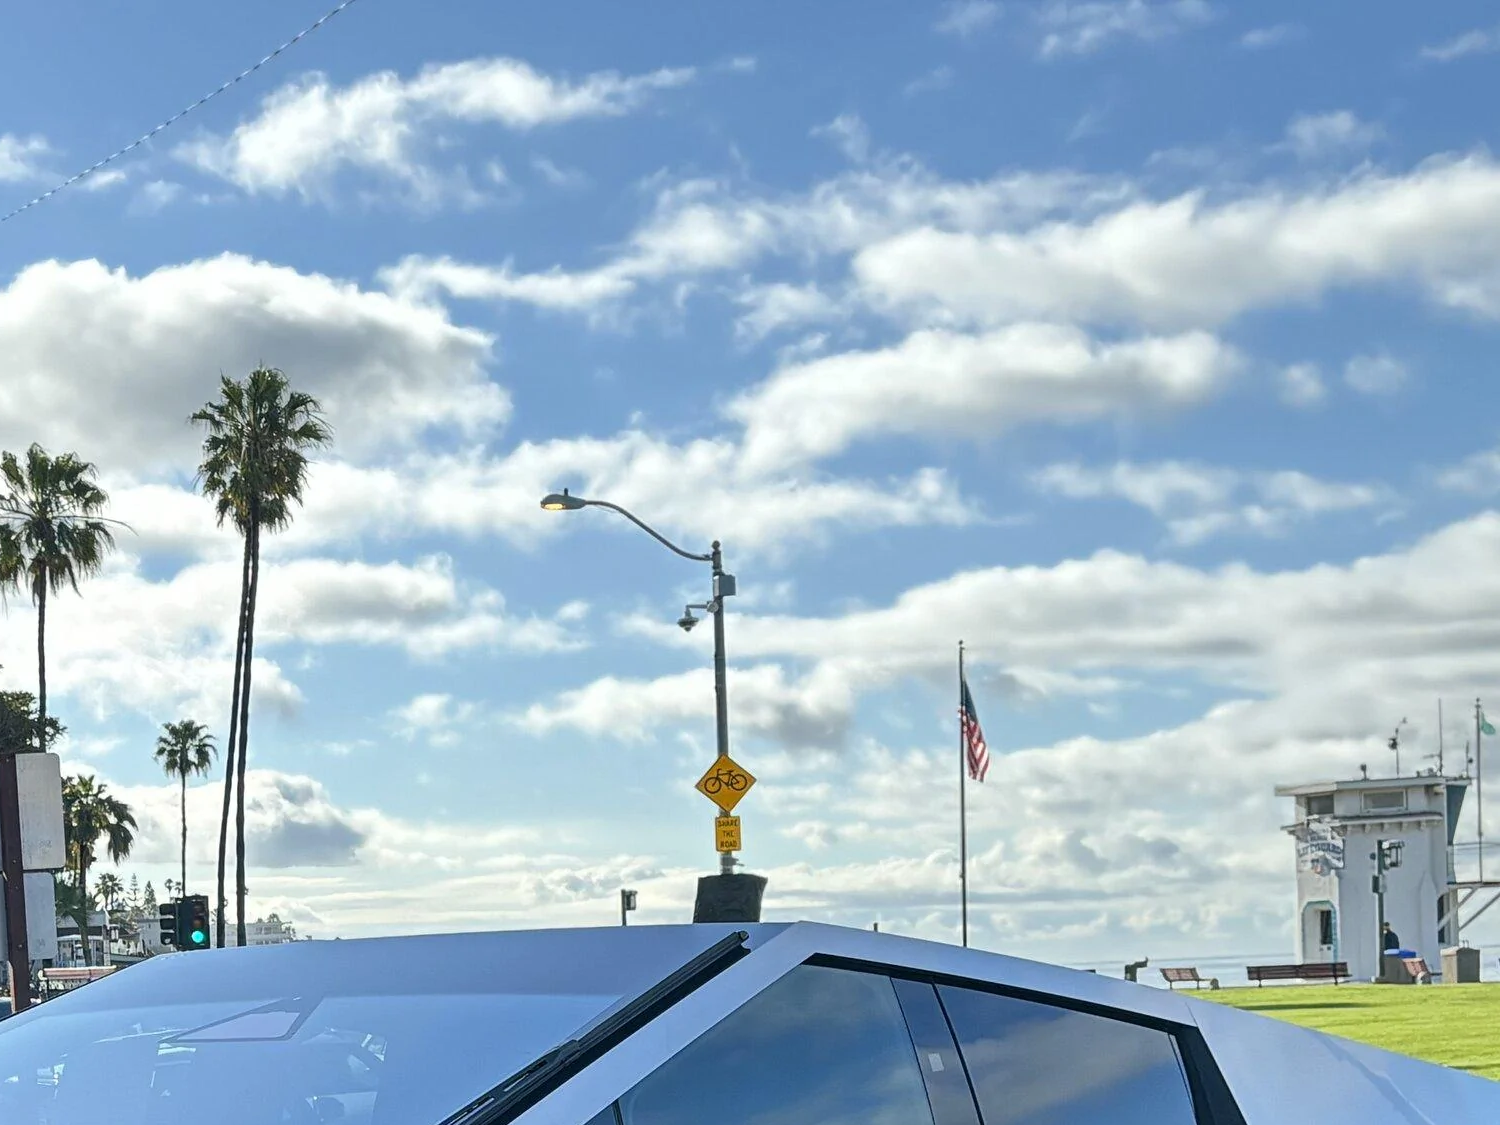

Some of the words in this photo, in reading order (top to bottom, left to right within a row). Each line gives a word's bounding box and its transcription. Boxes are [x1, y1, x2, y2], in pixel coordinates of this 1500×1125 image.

[717, 818, 739, 827] SHARE
[722, 829, 735, 838] THE
[720, 840, 738, 849] ROAD
